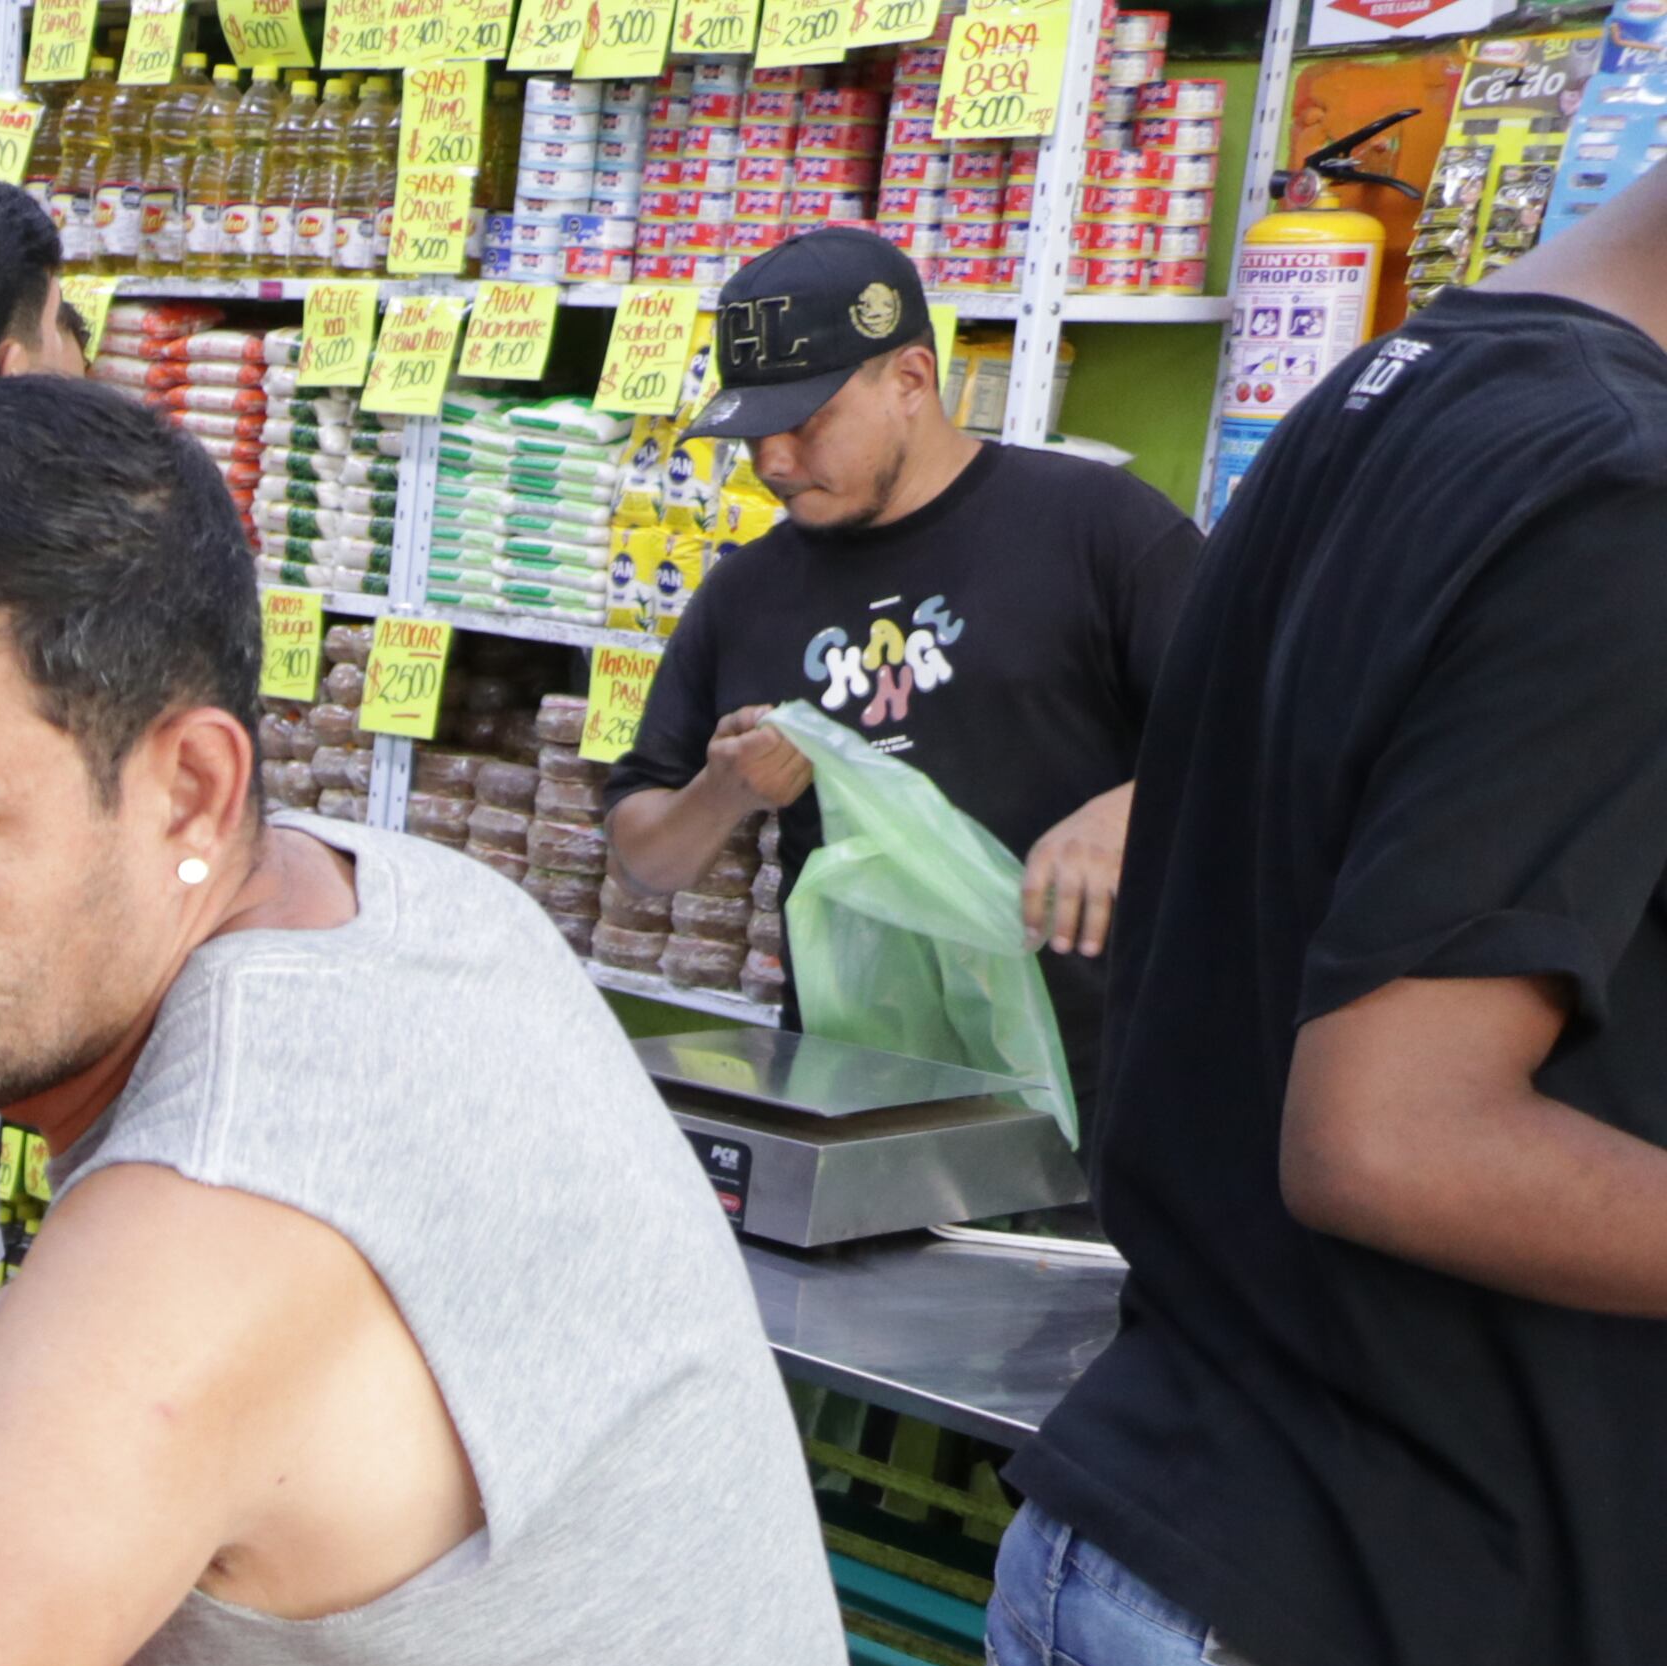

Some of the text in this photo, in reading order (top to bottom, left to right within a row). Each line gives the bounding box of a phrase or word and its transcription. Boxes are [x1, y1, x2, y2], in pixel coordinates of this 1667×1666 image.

[962, 59, 1030, 97] BBQ
[1242, 252, 1331, 268] XTINTOR
[307, 286, 364, 314] ACEITE
[719, 294, 811, 370] GL
